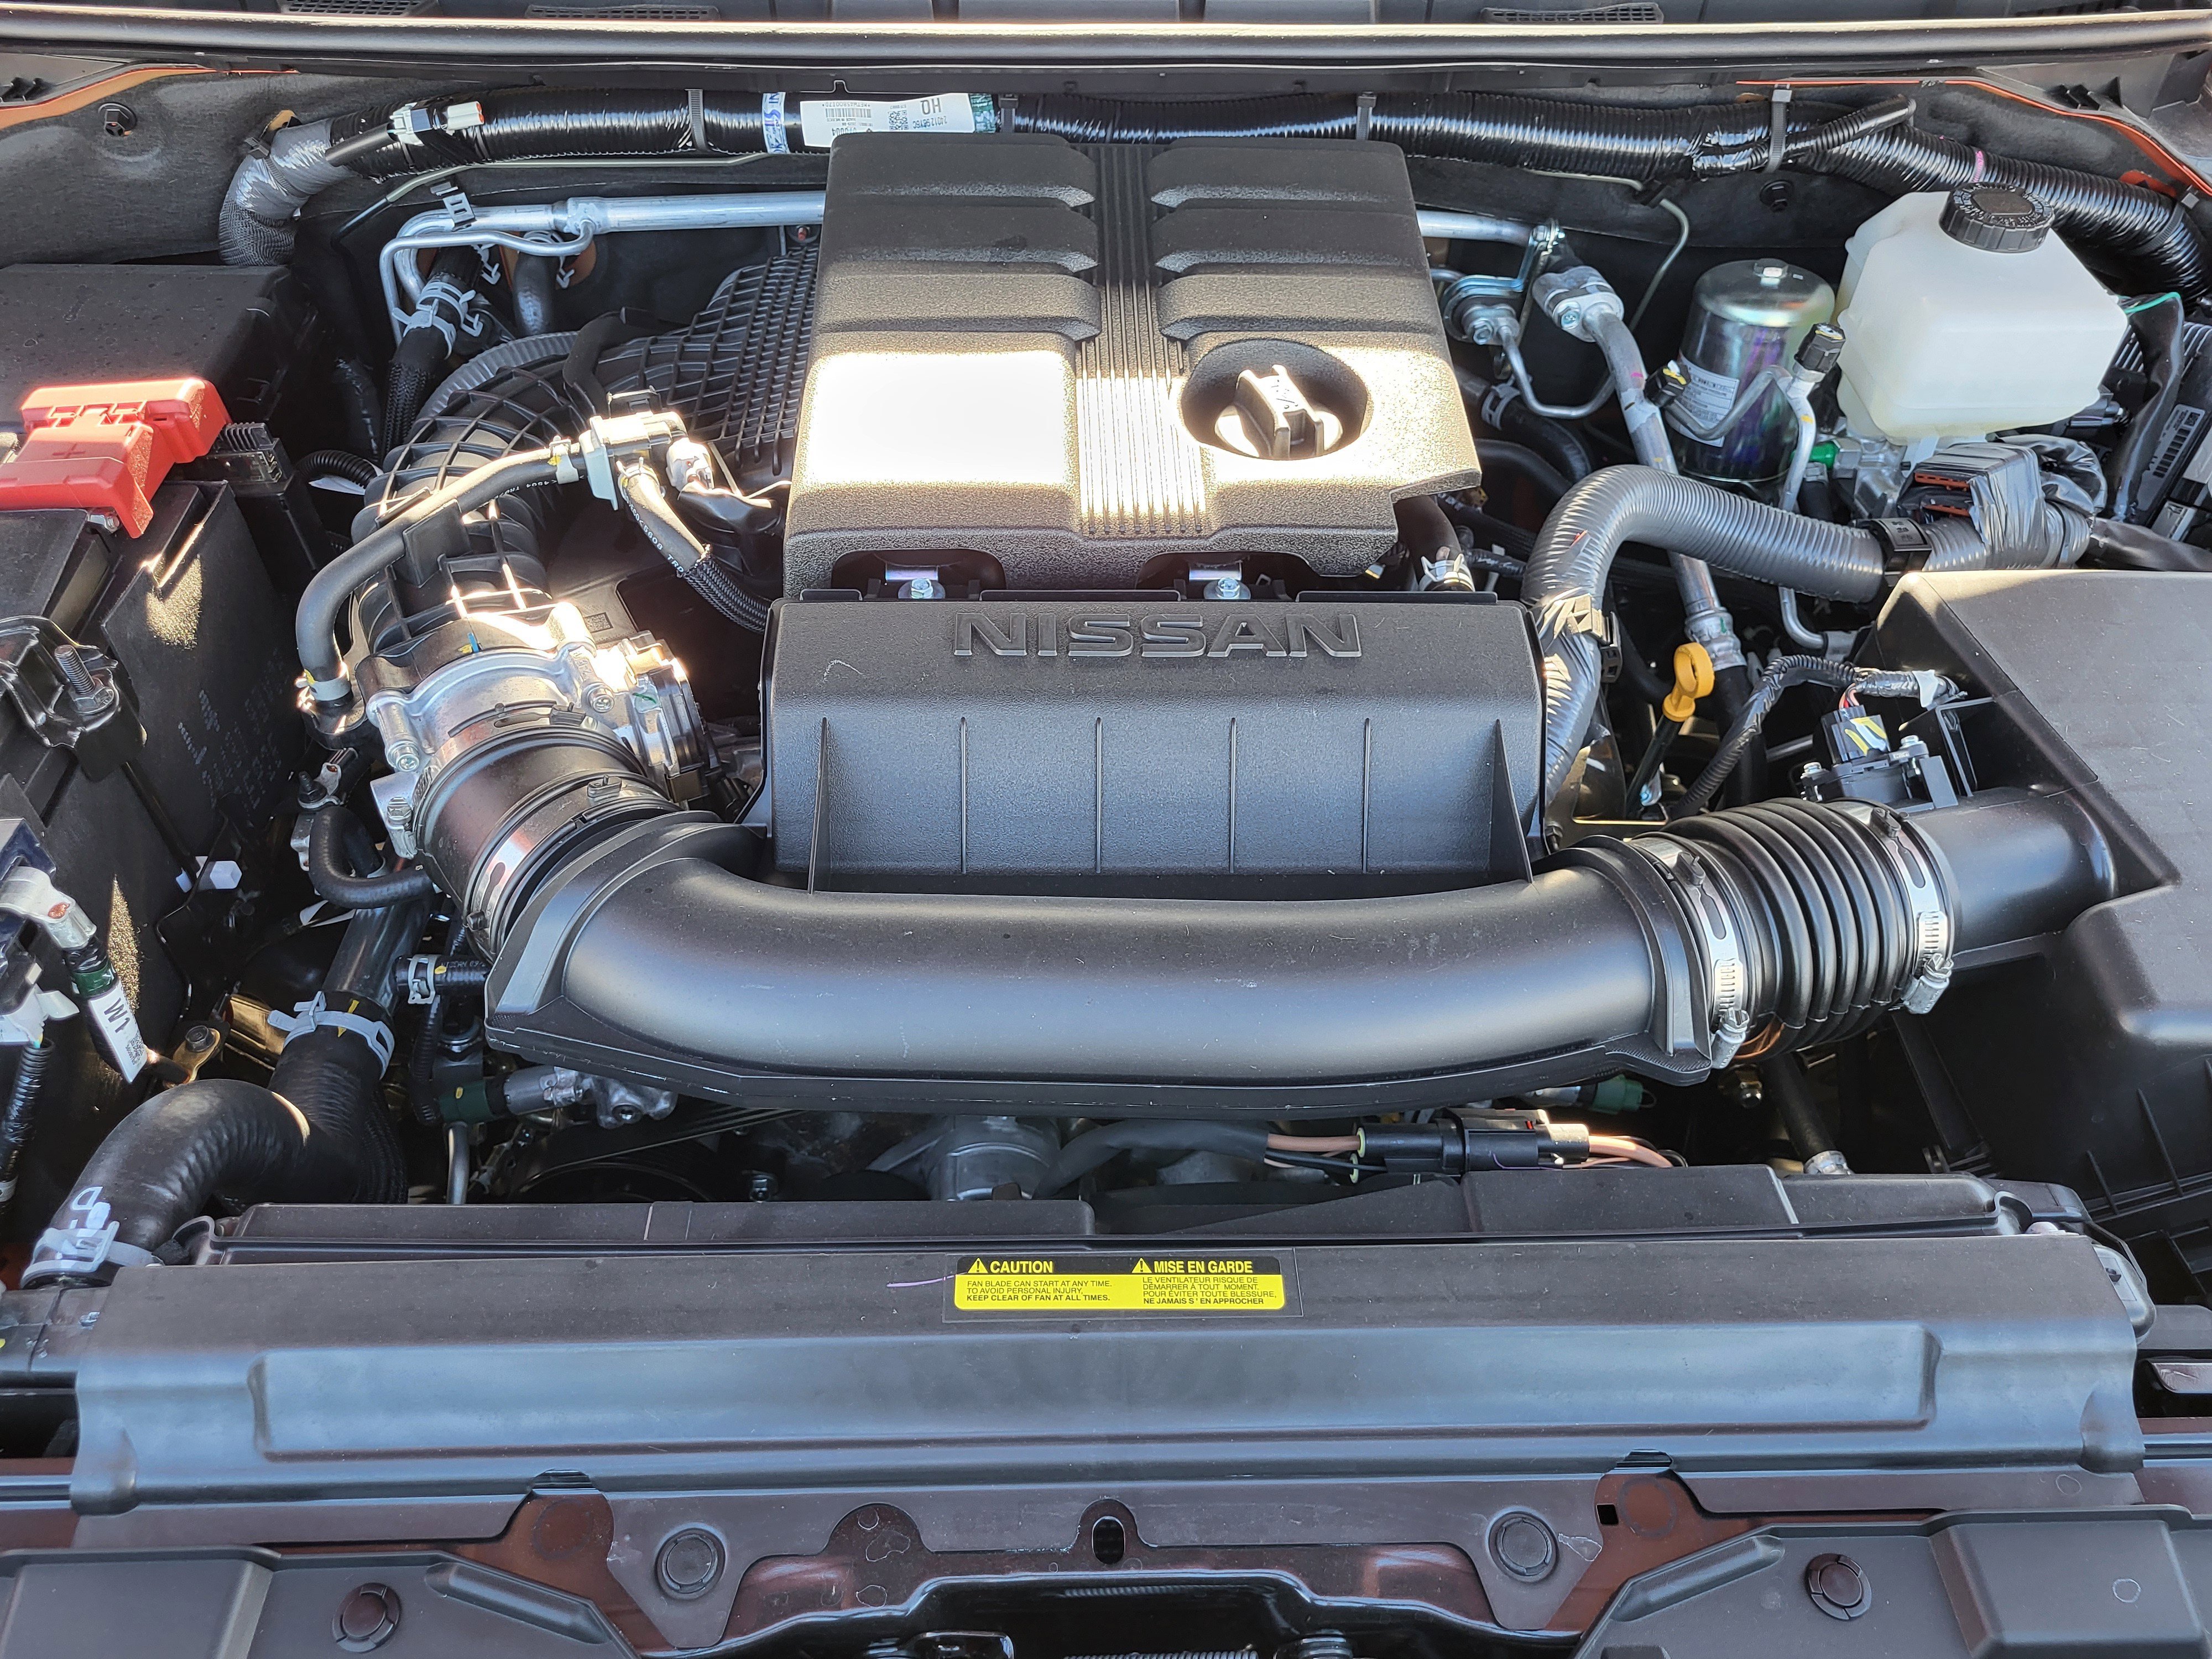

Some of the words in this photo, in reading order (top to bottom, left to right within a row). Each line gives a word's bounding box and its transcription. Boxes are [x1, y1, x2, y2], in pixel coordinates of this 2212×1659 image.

[920, 98, 941, 115] HQ
[667, 554, 685, 572] TRD
[954, 613, 1361, 658] NISSAN
[103, 997, 131, 1033] W1
[990, 1261, 1054, 1273] CAUTION
[1154, 1261, 1185, 1273] MISE
[1188, 1261, 1207, 1273] EN
[1208, 1261, 1253, 1273] GARDE
